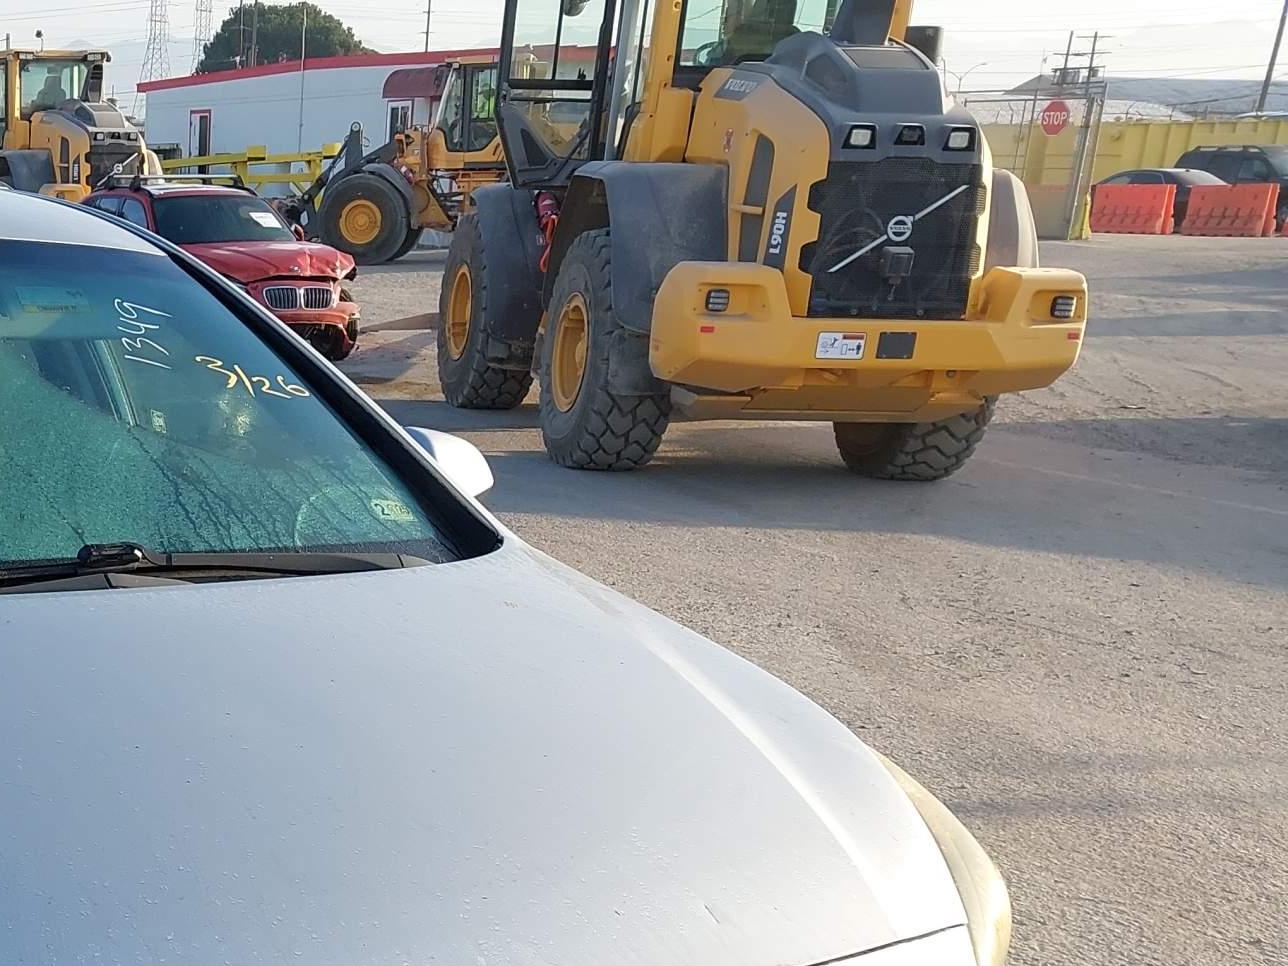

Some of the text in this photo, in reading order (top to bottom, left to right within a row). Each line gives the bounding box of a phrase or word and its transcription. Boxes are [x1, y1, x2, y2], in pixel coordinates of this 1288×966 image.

[1042, 111, 1068, 125] STOP
[769, 211, 788, 254] L90H
[114, 298, 173, 370] 1349
[195, 355, 311, 399] 3/26
